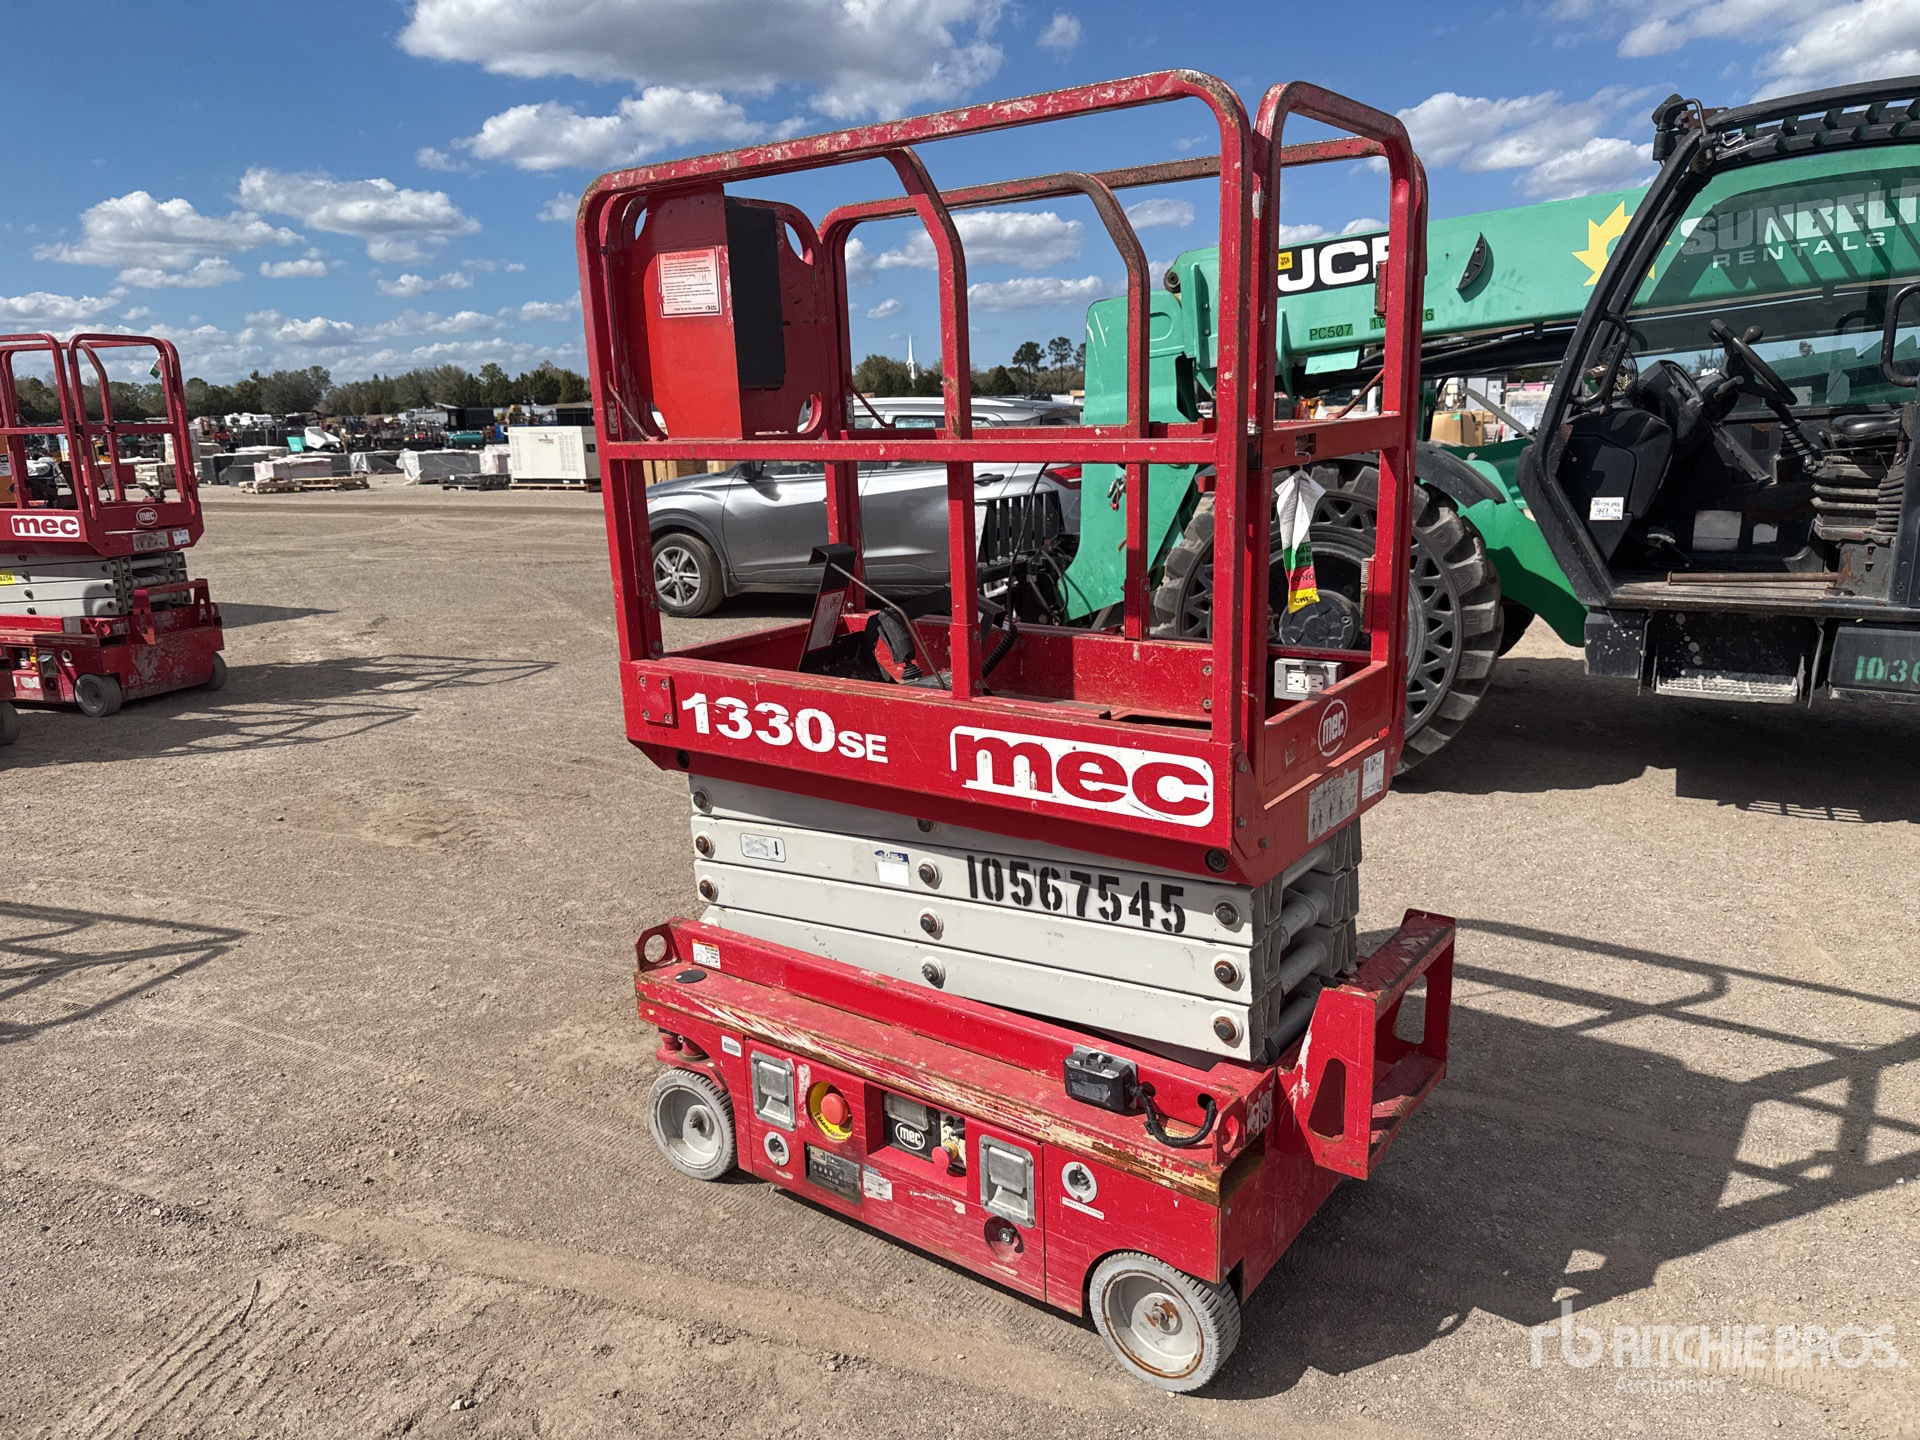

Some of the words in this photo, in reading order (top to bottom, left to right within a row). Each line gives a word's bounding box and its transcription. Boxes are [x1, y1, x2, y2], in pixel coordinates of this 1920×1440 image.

[1680, 186, 1920, 256] SUNBELT
[1712, 232, 1886, 269] RENTALS
[1309, 324, 1353, 340] PC507
[12, 517, 79, 536] mec
[138, 511, 156, 522] mec
[1322, 710, 1345, 747] mec
[954, 731, 1211, 818] mec
[966, 854, 1187, 934] 10567545
[900, 1126, 922, 1146] mec
